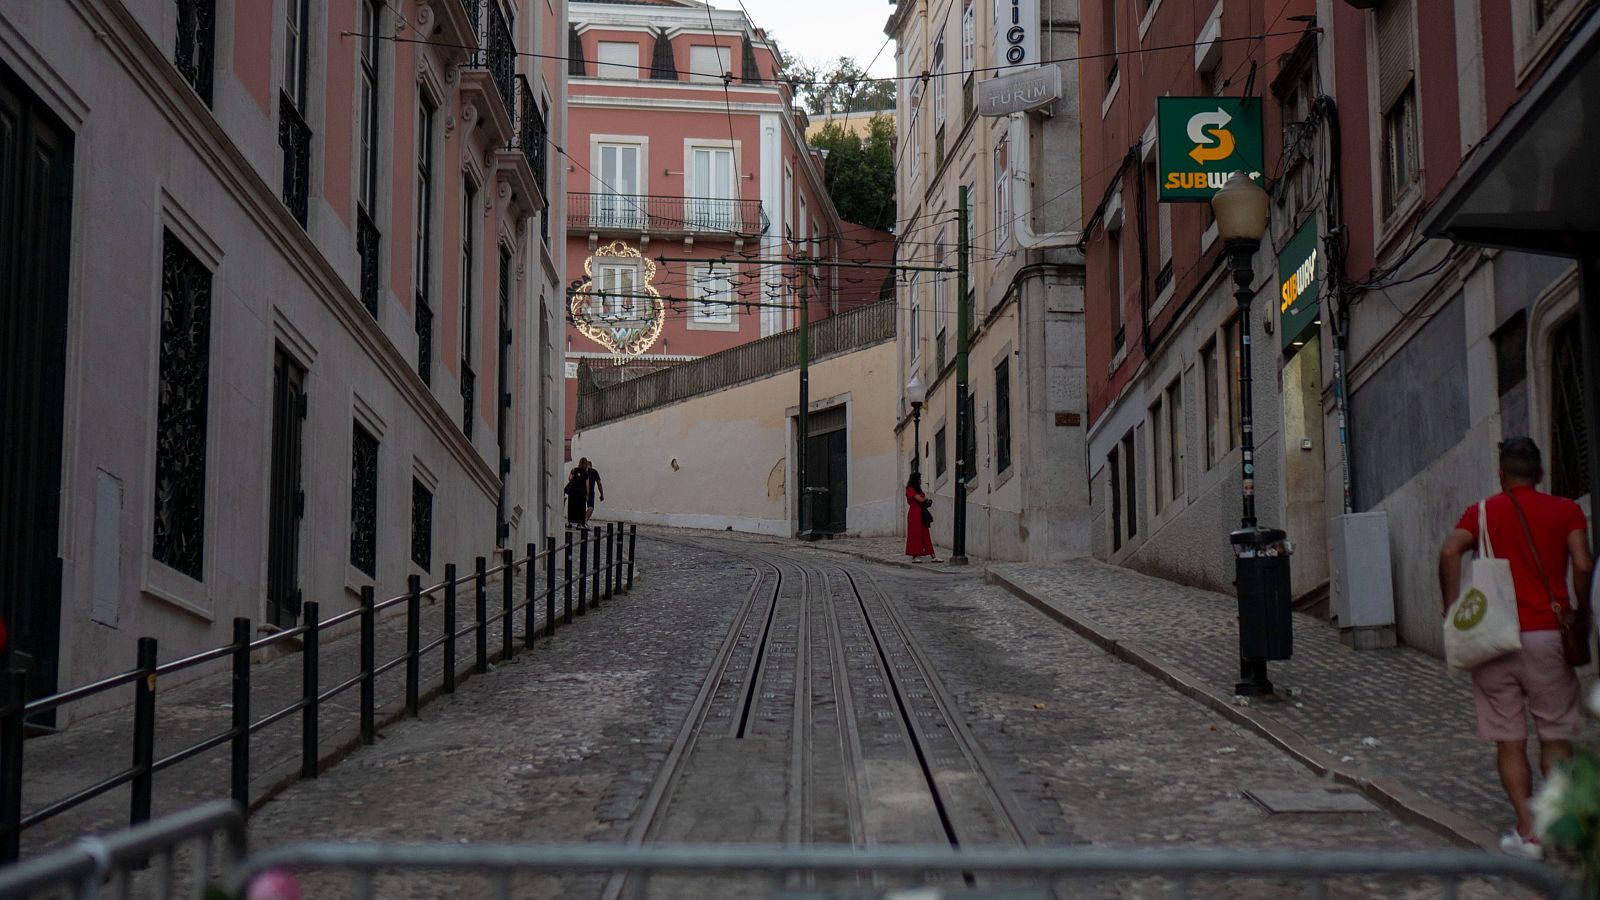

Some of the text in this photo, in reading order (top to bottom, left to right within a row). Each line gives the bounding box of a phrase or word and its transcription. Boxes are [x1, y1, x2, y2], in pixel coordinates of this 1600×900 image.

[989, 85, 1047, 107] TURIM
[1164, 171, 1262, 190] SUBW
[1281, 247, 1317, 315] SUBWAY
